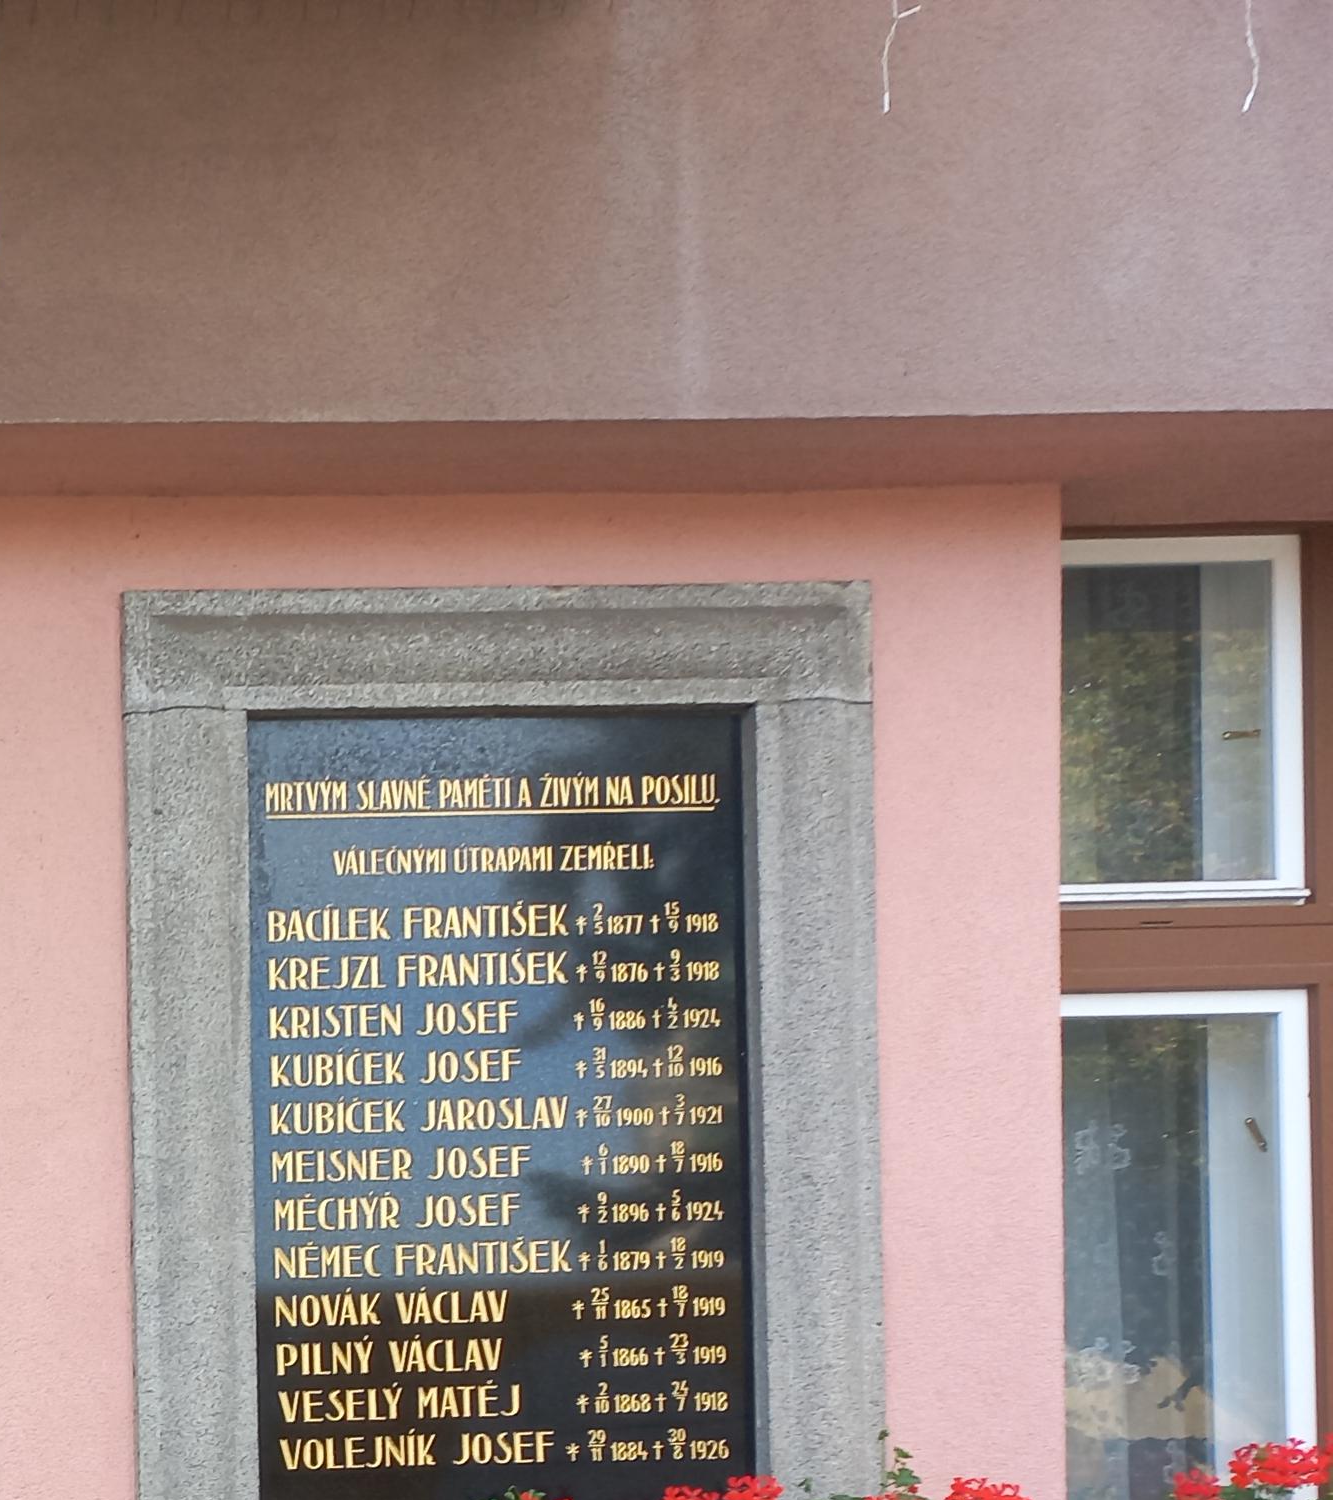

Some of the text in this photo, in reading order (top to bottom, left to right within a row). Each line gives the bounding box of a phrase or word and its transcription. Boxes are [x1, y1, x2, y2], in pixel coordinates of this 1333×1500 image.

[265, 775, 347, 813] MRTVÝM
[439, 775, 511, 810] PAMĚTI
[518, 778, 530, 808] A
[540, 772, 599, 808] ŽIVÝM
[605, 777, 633, 806] NA
[641, 773, 720, 806] POSILU.
[333, 844, 446, 876] VÁLEČNÝMI
[454, 842, 552, 873] ÚTRAPAMI
[267, 904, 391, 943] BACÍLEK
[404, 900, 569, 940] FRANTIŠEK
[607, 914, 644, 935] 1877
[685, 913, 719, 933] 1918
[268, 955, 387, 991] KREJZL
[397, 949, 569, 987] FRANTIŠEK
[611, 962, 648, 983] 1876
[686, 961, 720, 981] 1918
[269, 1003, 402, 1039] KRISTEN
[417, 1000, 520, 1037] JOSEF
[609, 1010, 646, 1030] 1886
[683, 1008, 721, 1029] 1924
[270, 1048, 405, 1089] KUBÍČEK
[420, 1048, 522, 1085] JOSEF
[610, 1059, 648, 1079] 1894
[689, 1056, 723, 1077] 1916
[269, 1095, 405, 1136] KUBÍČEK
[420, 1095, 568, 1132] JAROSLAV
[616, 1108, 654, 1127] 1900
[689, 1105, 723, 1125] 1921
[271, 1147, 412, 1183] MEISNER
[428, 1144, 532, 1181] JOSEF
[612, 1154, 650, 1175] 1890
[690, 1152, 723, 1172] 1916
[416, 1193, 521, 1229] JOSEF
[612, 1203, 649, 1223] 1896
[685, 1200, 725, 1221] 1924
[273, 1238, 381, 1280] NĚMEC
[394, 1236, 572, 1277] FRANTIŠEK
[612, 1251, 650, 1271] 1879
[691, 1250, 725, 1269] 1919
[274, 1287, 381, 1328] NOVÁK
[395, 1288, 508, 1326] VÁCLAV
[614, 1299, 652, 1320] 1865
[693, 1297, 726, 1317] 1919
[275, 1335, 373, 1377] PILNÝ
[389, 1335, 503, 1374] VÁCLAV
[693, 1346, 727, 1365] 1919
[277, 1382, 404, 1423] VESELÝ
[418, 1380, 521, 1419] MATĚJ
[694, 1391, 728, 1412] 1918
[279, 1429, 437, 1471] VOLEJNÍK
[453, 1430, 555, 1466] JOSEF
[610, 1441, 649, 1462] 1884
[689, 1440, 729, 1460] 1926
